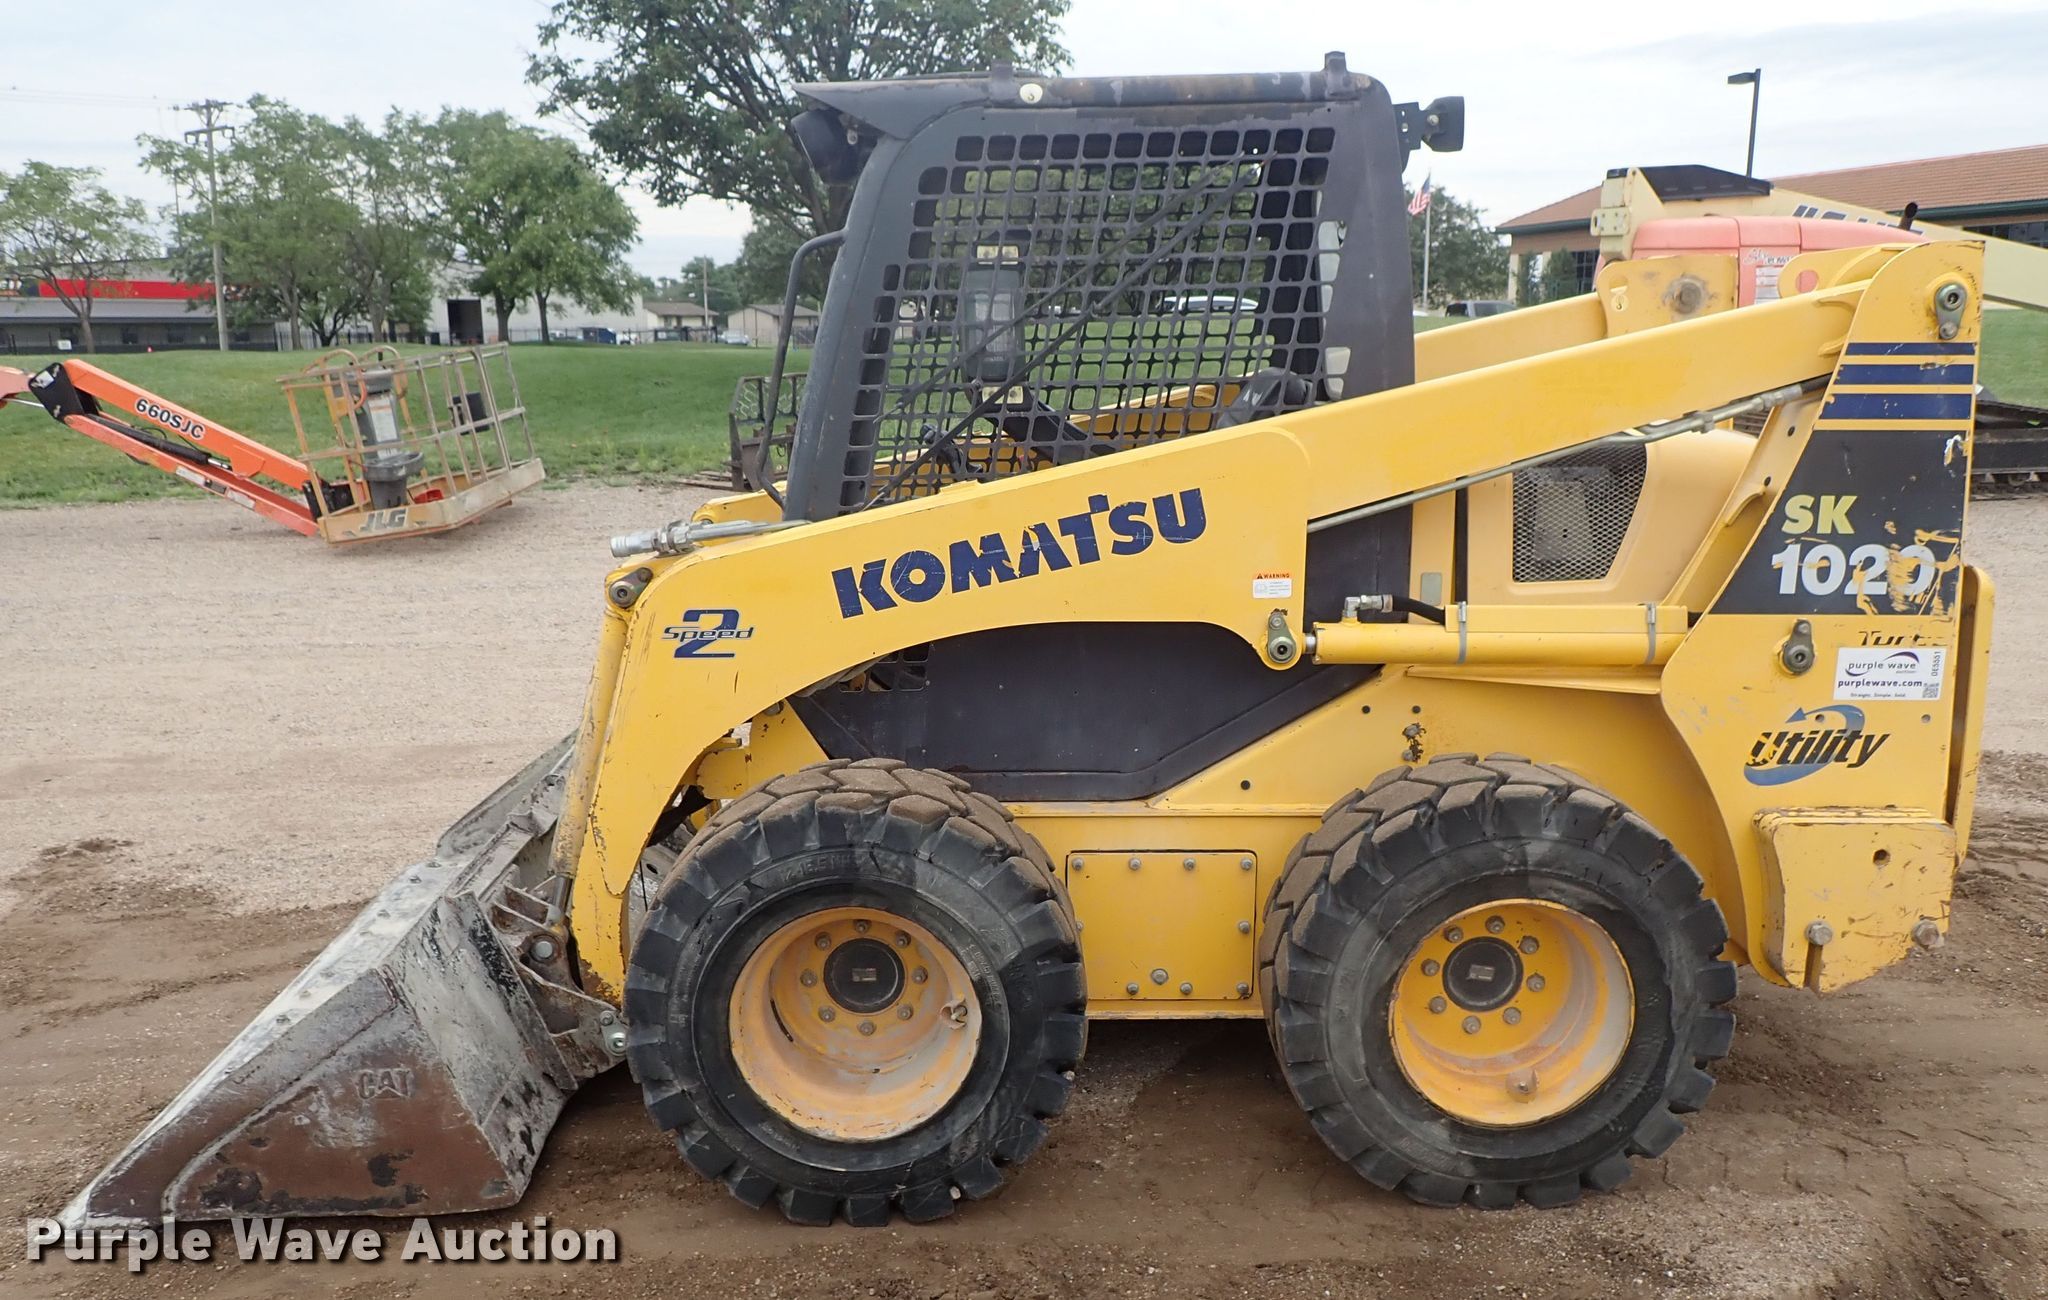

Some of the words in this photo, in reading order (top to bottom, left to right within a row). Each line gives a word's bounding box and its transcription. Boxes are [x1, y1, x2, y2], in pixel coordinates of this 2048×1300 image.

[136, 398, 204, 439] 660SJC
[360, 508, 406, 531] JLG
[1781, 494, 1858, 535] SK
[831, 487, 1207, 619] KOMATSU
[1771, 543, 1936, 596] 1020
[661, 626, 754, 642] Speed
[674, 609, 740, 658] 2
[1838, 679, 1923, 688] purplewave.com
[1848, 661, 1884, 671] purple
[1745, 729, 1891, 768] Utility
[357, 1068, 415, 1099] CAT
